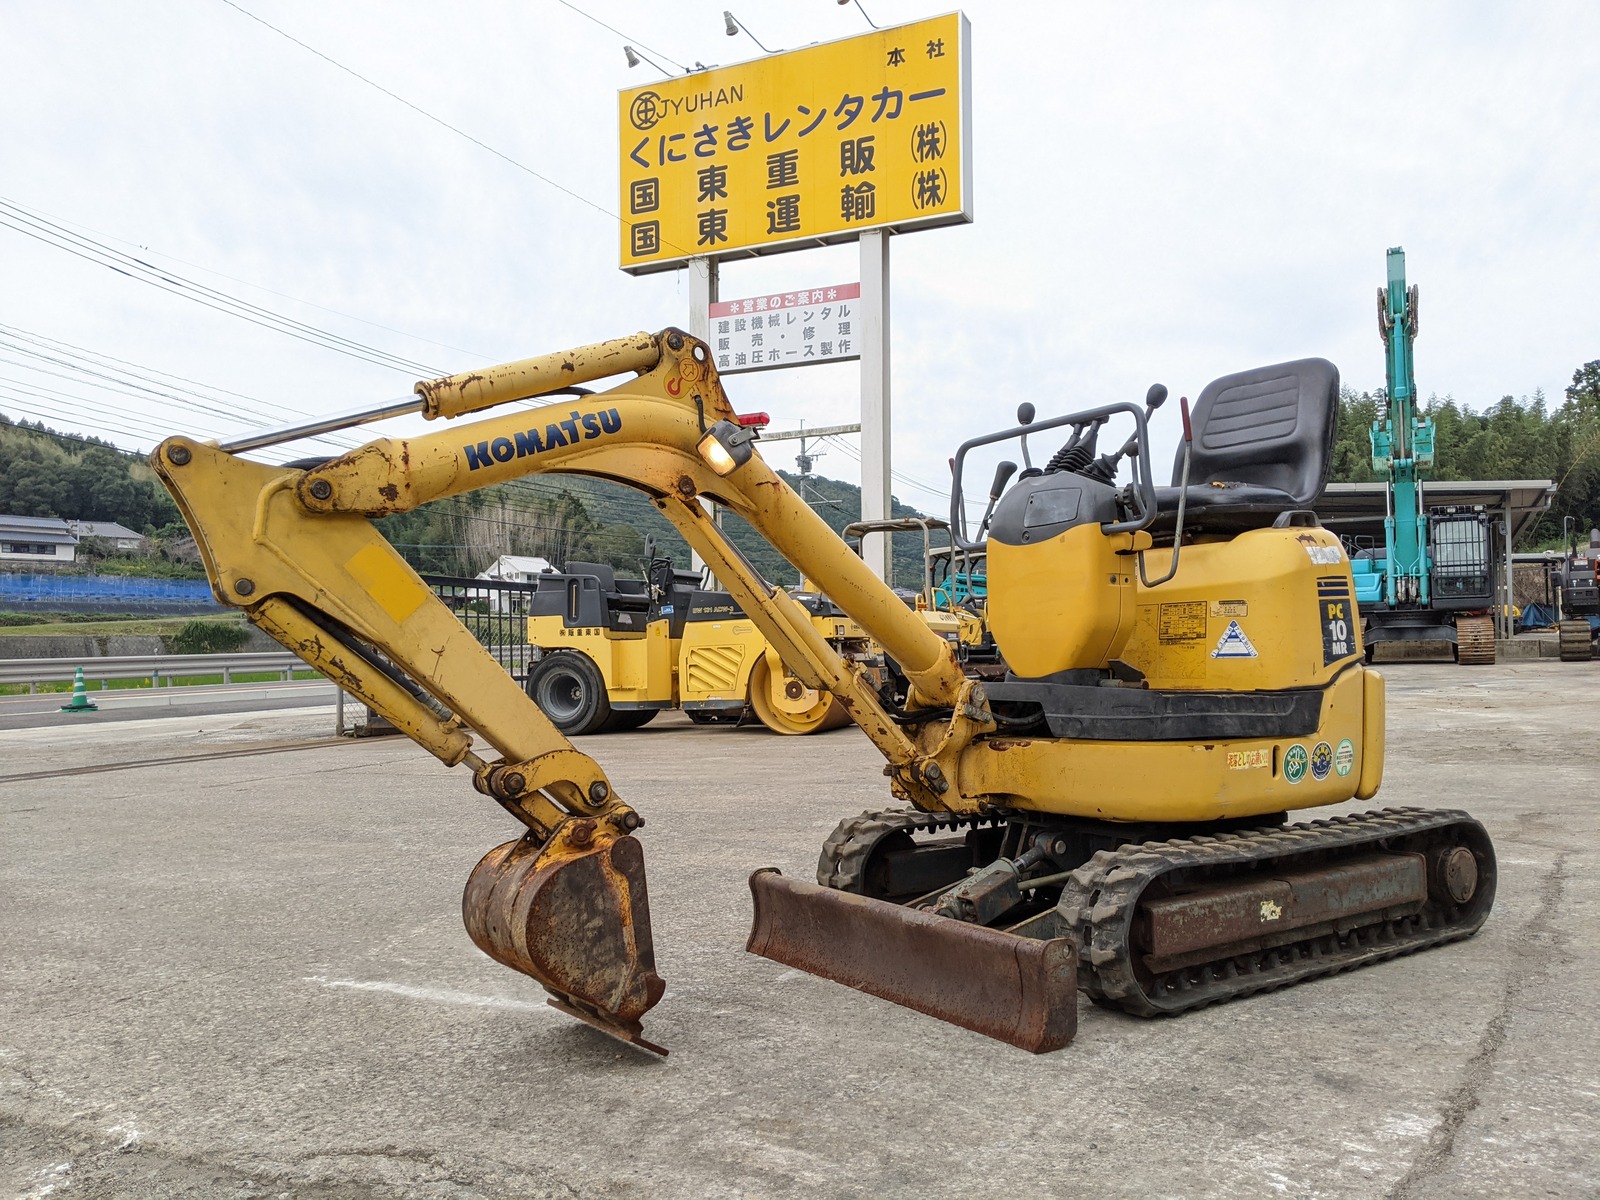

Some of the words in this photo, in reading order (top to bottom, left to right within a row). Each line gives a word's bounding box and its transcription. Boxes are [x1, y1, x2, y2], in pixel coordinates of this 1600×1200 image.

[886, 38, 945, 67] 本社
[656, 84, 743, 119] JYUHAN
[629, 86, 946, 169] くにさきレンタカー
[718, 304, 851, 335] 建設機械レンタル
[718, 339, 851, 368] 高油圧ホース製作
[463, 408, 622, 471] KOMATSU
[1327, 603, 1344, 619] PC
[1329, 620, 1347, 640] 10
[1332, 641, 1348, 655] MR
